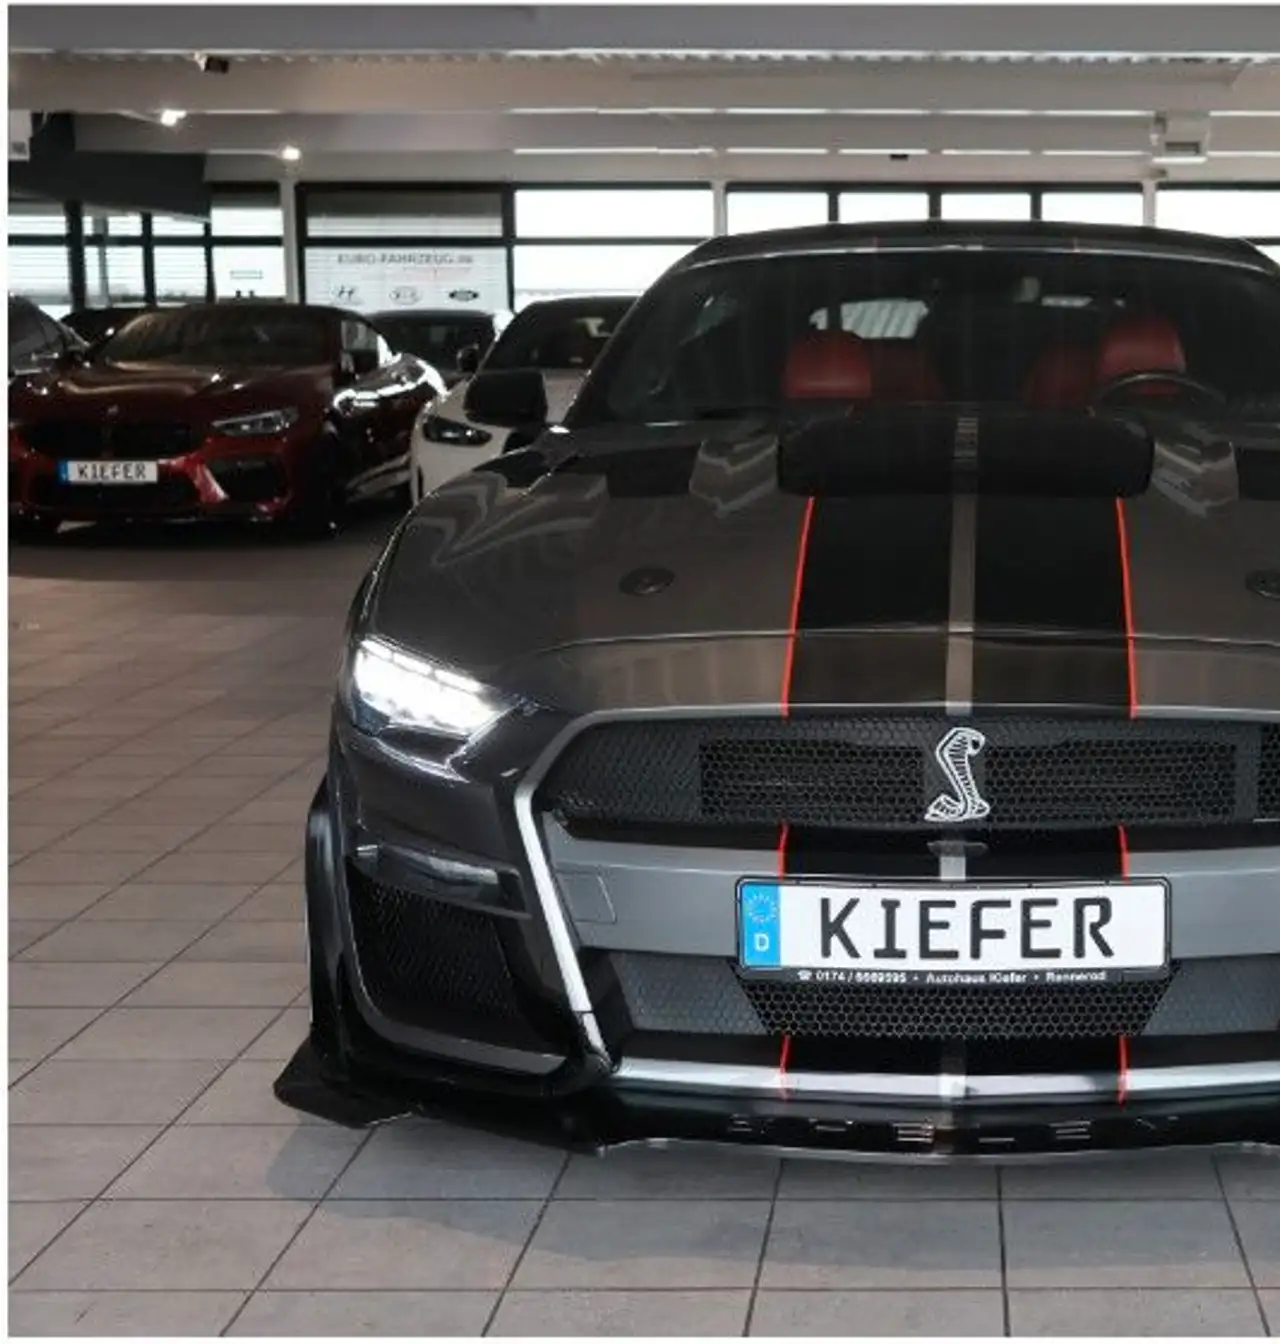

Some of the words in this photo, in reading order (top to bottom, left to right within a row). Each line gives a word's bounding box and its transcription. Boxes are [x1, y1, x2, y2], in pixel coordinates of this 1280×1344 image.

[77, 462, 146, 480] KIEFER
[754, 932, 769, 952] D
[820, 896, 1114, 960] KIEFER
